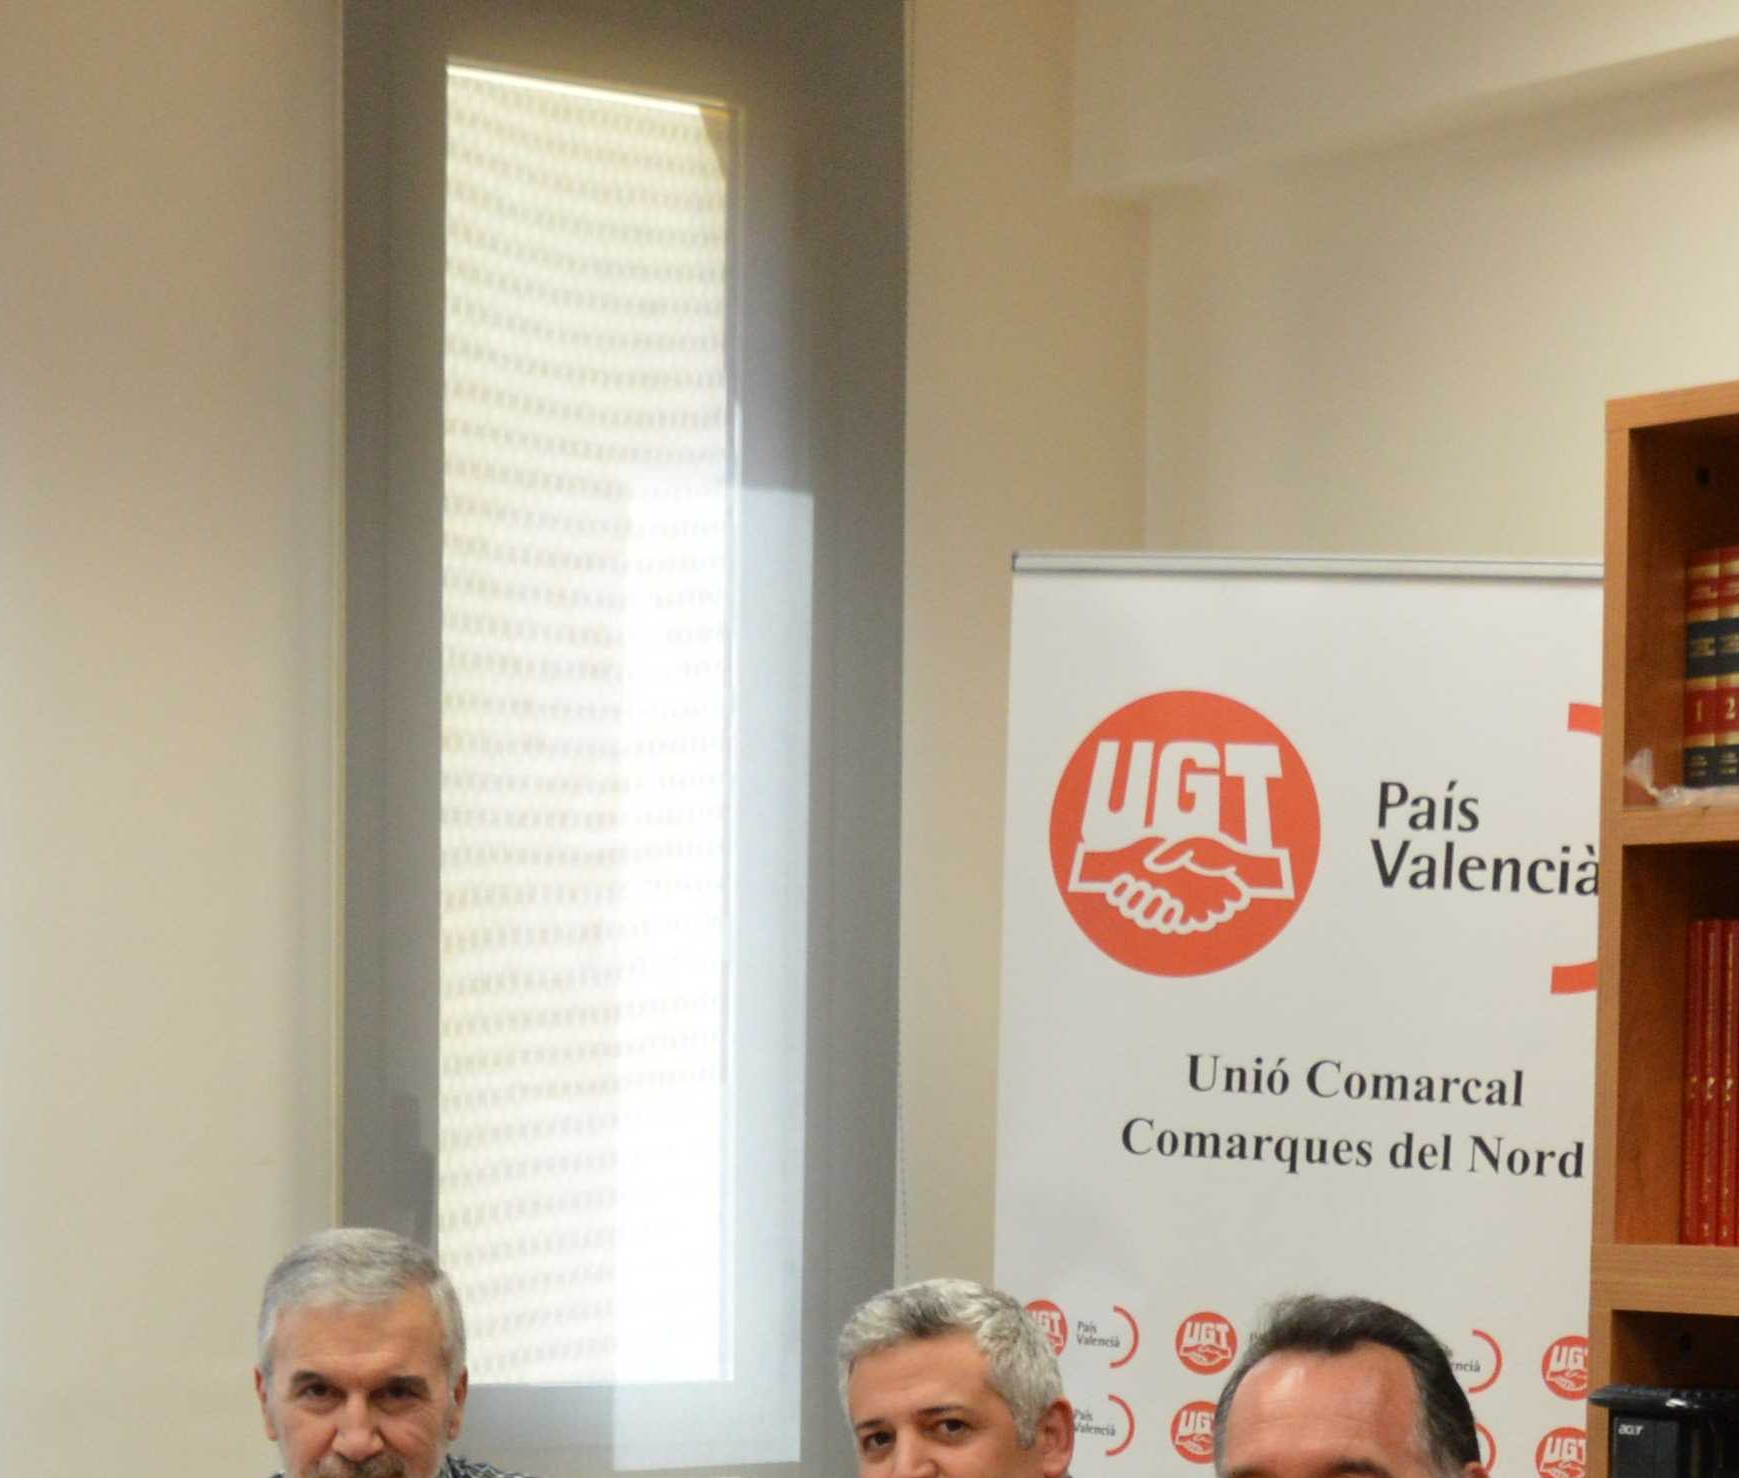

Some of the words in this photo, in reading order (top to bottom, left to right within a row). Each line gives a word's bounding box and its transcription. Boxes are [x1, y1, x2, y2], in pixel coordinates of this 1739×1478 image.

[1726, 697, 1736, 720] 2
[1081, 739, 1283, 850] UGT
[1377, 780, 1480, 832] País
[1371, 838, 1600, 895] Valencià
[1187, 1053, 1290, 1097] Unió
[1306, 1059, 1525, 1107] Comarcal
[1121, 1117, 1374, 1174] Comarques
[1390, 1133, 1452, 1171] del
[1468, 1137, 1585, 1179] Nord
[1077, 1321, 1097, 1333] País
[1185, 1321, 1230, 1347] UGT
[1077, 1334, 1120, 1348] Valencià
[1180, 1411, 1216, 1434] UG
[1618, 1423, 1643, 1436] acer
